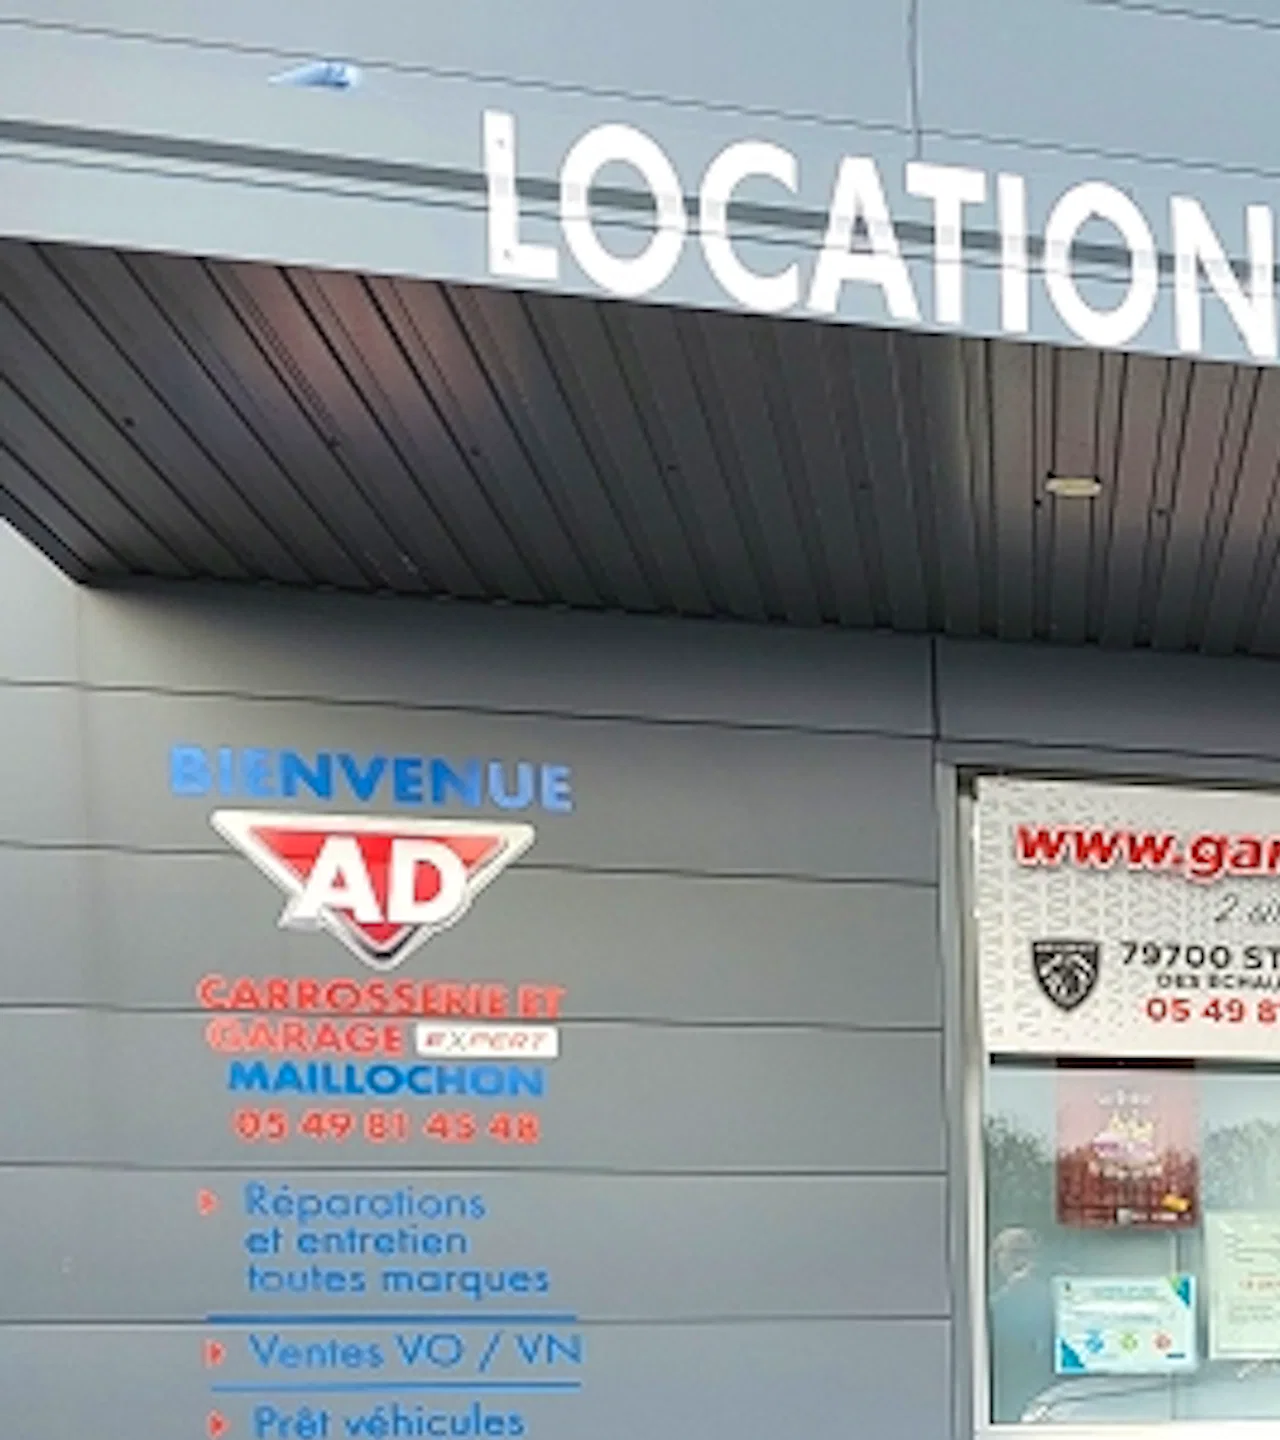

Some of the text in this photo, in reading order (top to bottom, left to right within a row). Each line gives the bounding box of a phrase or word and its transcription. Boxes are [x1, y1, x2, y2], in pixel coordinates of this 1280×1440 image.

[482, 109, 1279, 360] LOCATION
[169, 743, 575, 812] BIENVENUE
[278, 835, 471, 929] AD
[1120, 941, 1231, 968] 79700
[196, 975, 566, 1020] CARROSSERIE ET
[1146, 998, 1190, 1022] 05
[1203, 999, 1244, 1023] 49
[207, 1016, 548, 1055] GARAGE EXPERT
[228, 1060, 546, 1096] MAILLOCHON
[234, 1109, 541, 1144] 05 49 81 45 48
[242, 1181, 486, 1224] Réparations
[244, 1224, 469, 1255] et entretien
[247, 1263, 550, 1300] toutes marques
[248, 1333, 385, 1368] Ventes
[395, 1333, 464, 1366] VO
[515, 1332, 584, 1365] VN
[252, 1401, 525, 1440] Prêt véhicules
